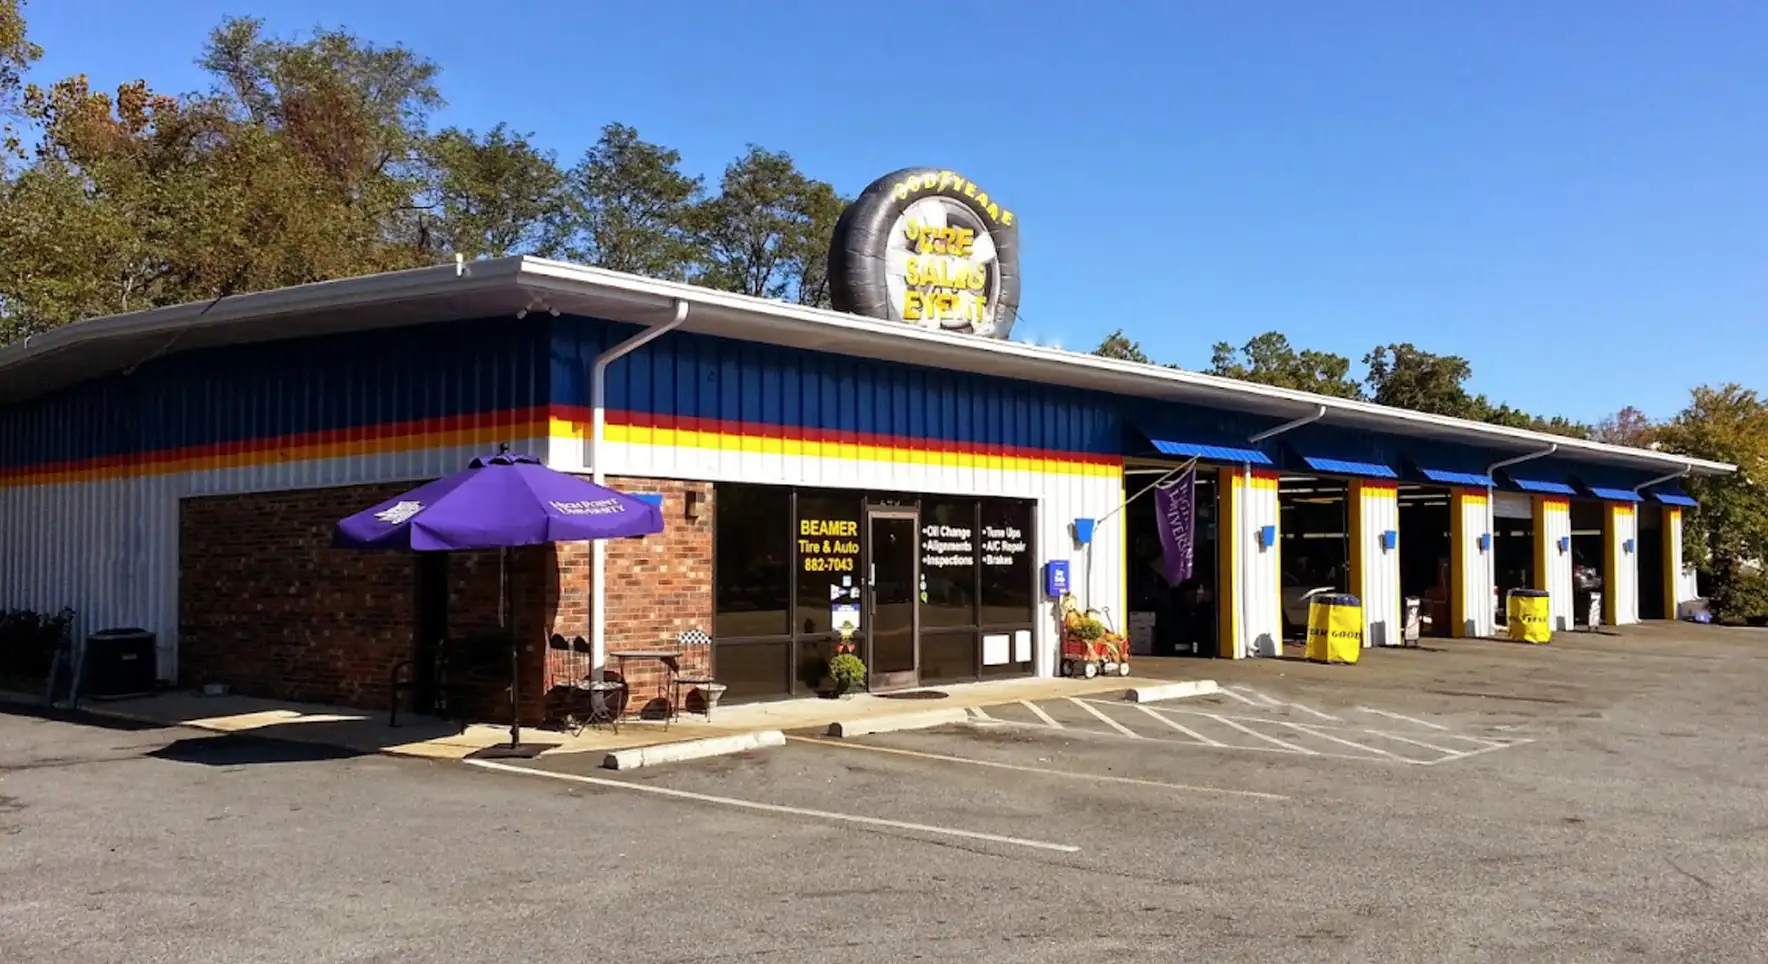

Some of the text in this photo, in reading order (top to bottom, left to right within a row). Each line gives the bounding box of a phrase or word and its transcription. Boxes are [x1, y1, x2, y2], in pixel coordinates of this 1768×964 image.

[800, 519, 858, 536] BEAMER
[940, 525, 971, 540] Change
[985, 525, 1021, 540] Tune Ups
[798, 539, 860, 553] Tire & Auto
[926, 539, 972, 554] Alignments
[1001, 540, 1026, 554] Repair
[804, 557, 853, 571] 882-7043
[926, 554, 974, 568] Inspections
[986, 554, 1013, 565] Brakes
